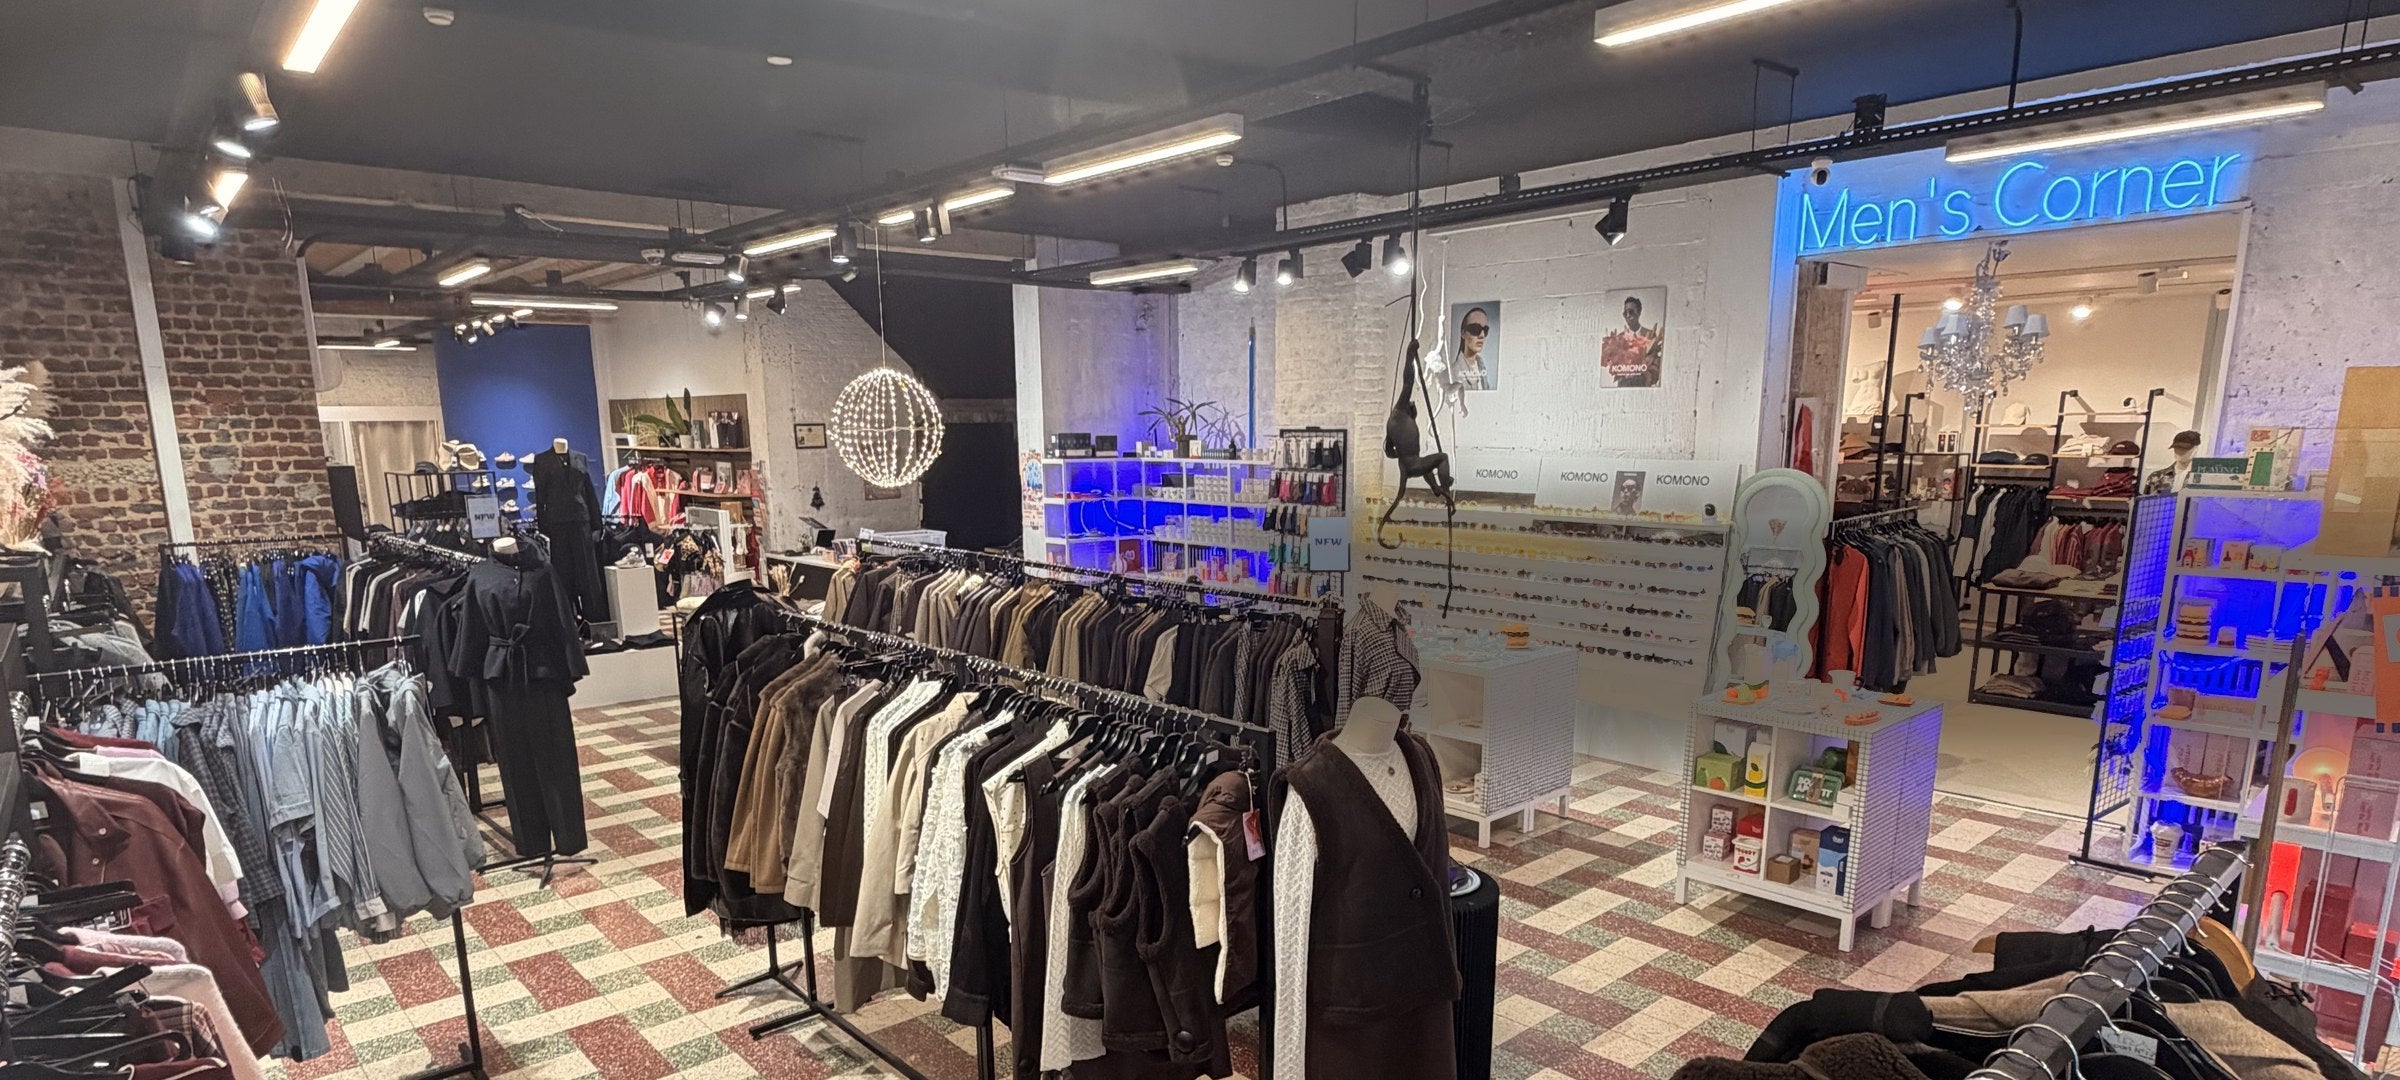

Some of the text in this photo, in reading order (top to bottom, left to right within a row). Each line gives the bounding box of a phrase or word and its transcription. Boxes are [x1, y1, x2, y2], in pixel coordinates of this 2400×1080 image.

[1799, 152, 2241, 252] Men's Corner
[1611, 364, 1648, 372] KOMONO
[1475, 468, 1519, 480] KOMONO
[1560, 471, 1609, 483] KOMONO
[1655, 474, 1711, 487] KOMONO
